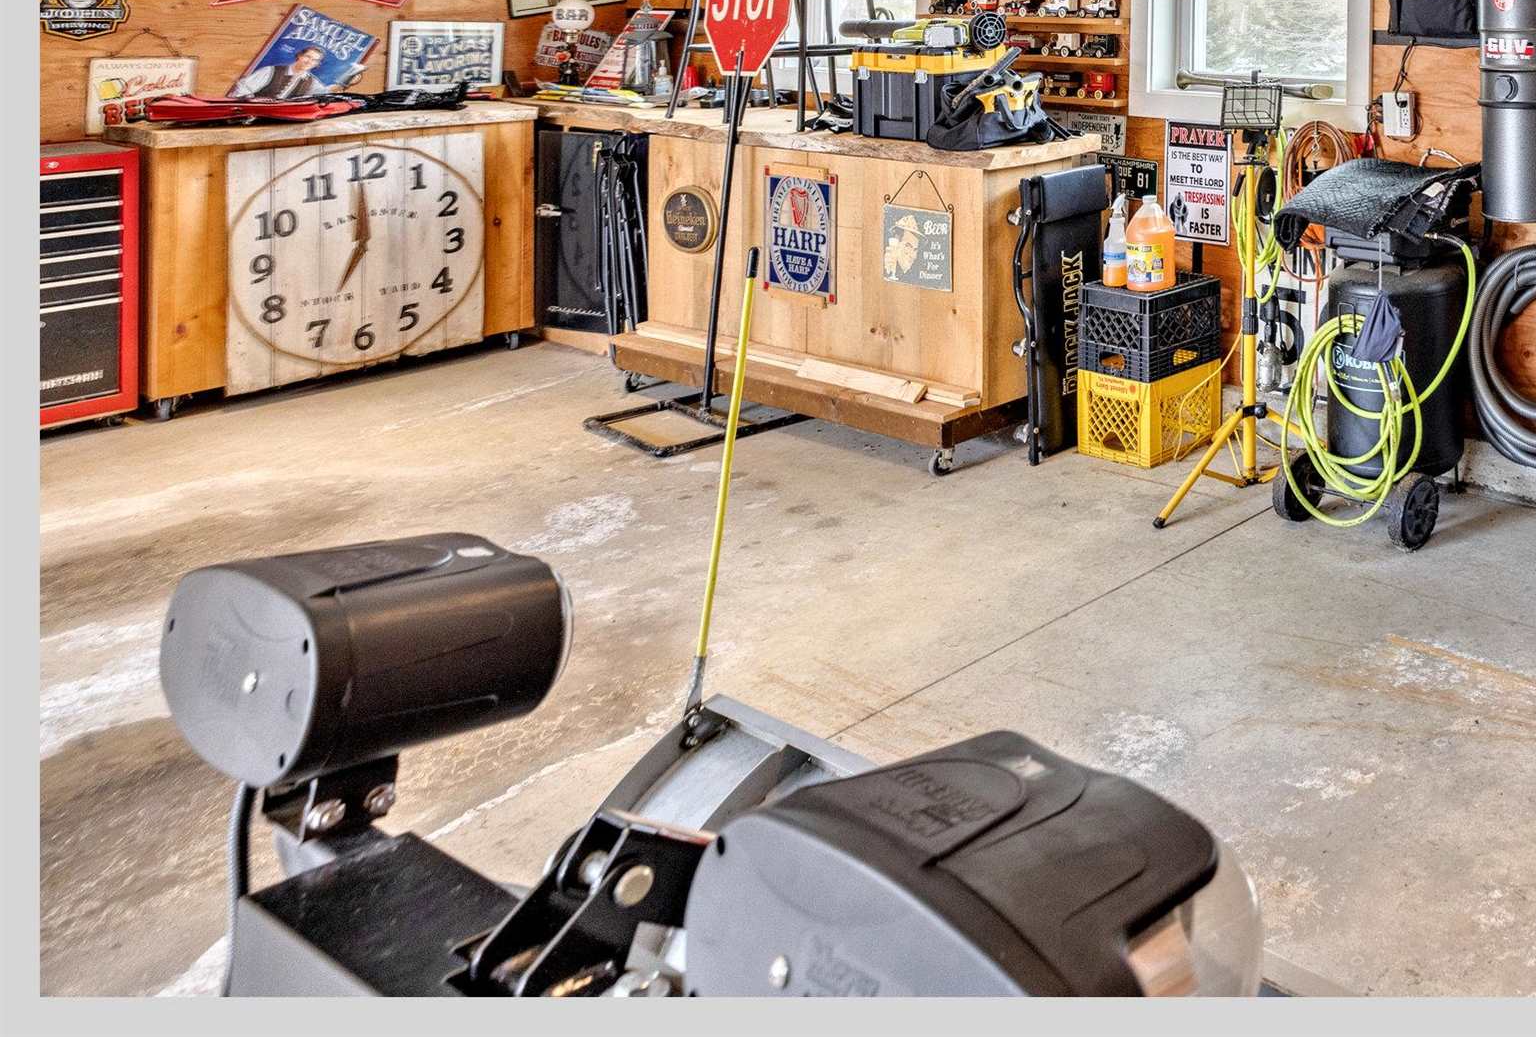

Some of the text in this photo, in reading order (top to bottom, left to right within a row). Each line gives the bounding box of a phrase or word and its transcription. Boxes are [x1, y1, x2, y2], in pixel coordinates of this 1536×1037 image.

[555, 7, 589, 21] BAR
[291, 8, 371, 52] SAMUEL
[283, 26, 351, 61] ADAMS
[1487, 37, 1529, 54] GUV
[96, 63, 140, 71] ALWAYS
[161, 63, 184, 71] TAP
[402, 52, 491, 73] FLAVORING
[402, 66, 491, 84] EXTRACTS
[1071, 121, 1112, 133] INDEPENDENT
[1171, 126, 1226, 147] PRAYER
[1171, 150, 1224, 163] IS THE BEST WAY
[347, 152, 388, 184] 12
[409, 163, 428, 191] 1
[1190, 163, 1203, 174] TO
[301, 172, 338, 204] 11
[1137, 172, 1150, 189] 81
[1169, 174, 1225, 188] MEET THE LORD
[436, 190, 459, 218] 2
[1184, 190, 1226, 206] TRESPASSING
[1201, 207, 1210, 220] IS
[255, 209, 299, 241] 10
[1189, 221, 1222, 236] FASTER
[443, 227, 466, 254] 3
[773, 226, 827, 253] HARP
[930, 241, 941, 251] It's
[922, 251, 945, 261] What's
[249, 254, 275, 285] 9
[788, 263, 811, 275] HARP
[919, 270, 944, 280] Dinner
[926, 262, 940, 271] For
[431, 266, 455, 295] 4
[260, 294, 287, 324] 8
[399, 302, 420, 332] 5
[304, 318, 332, 349] 7
[353, 323, 376, 351] 6
